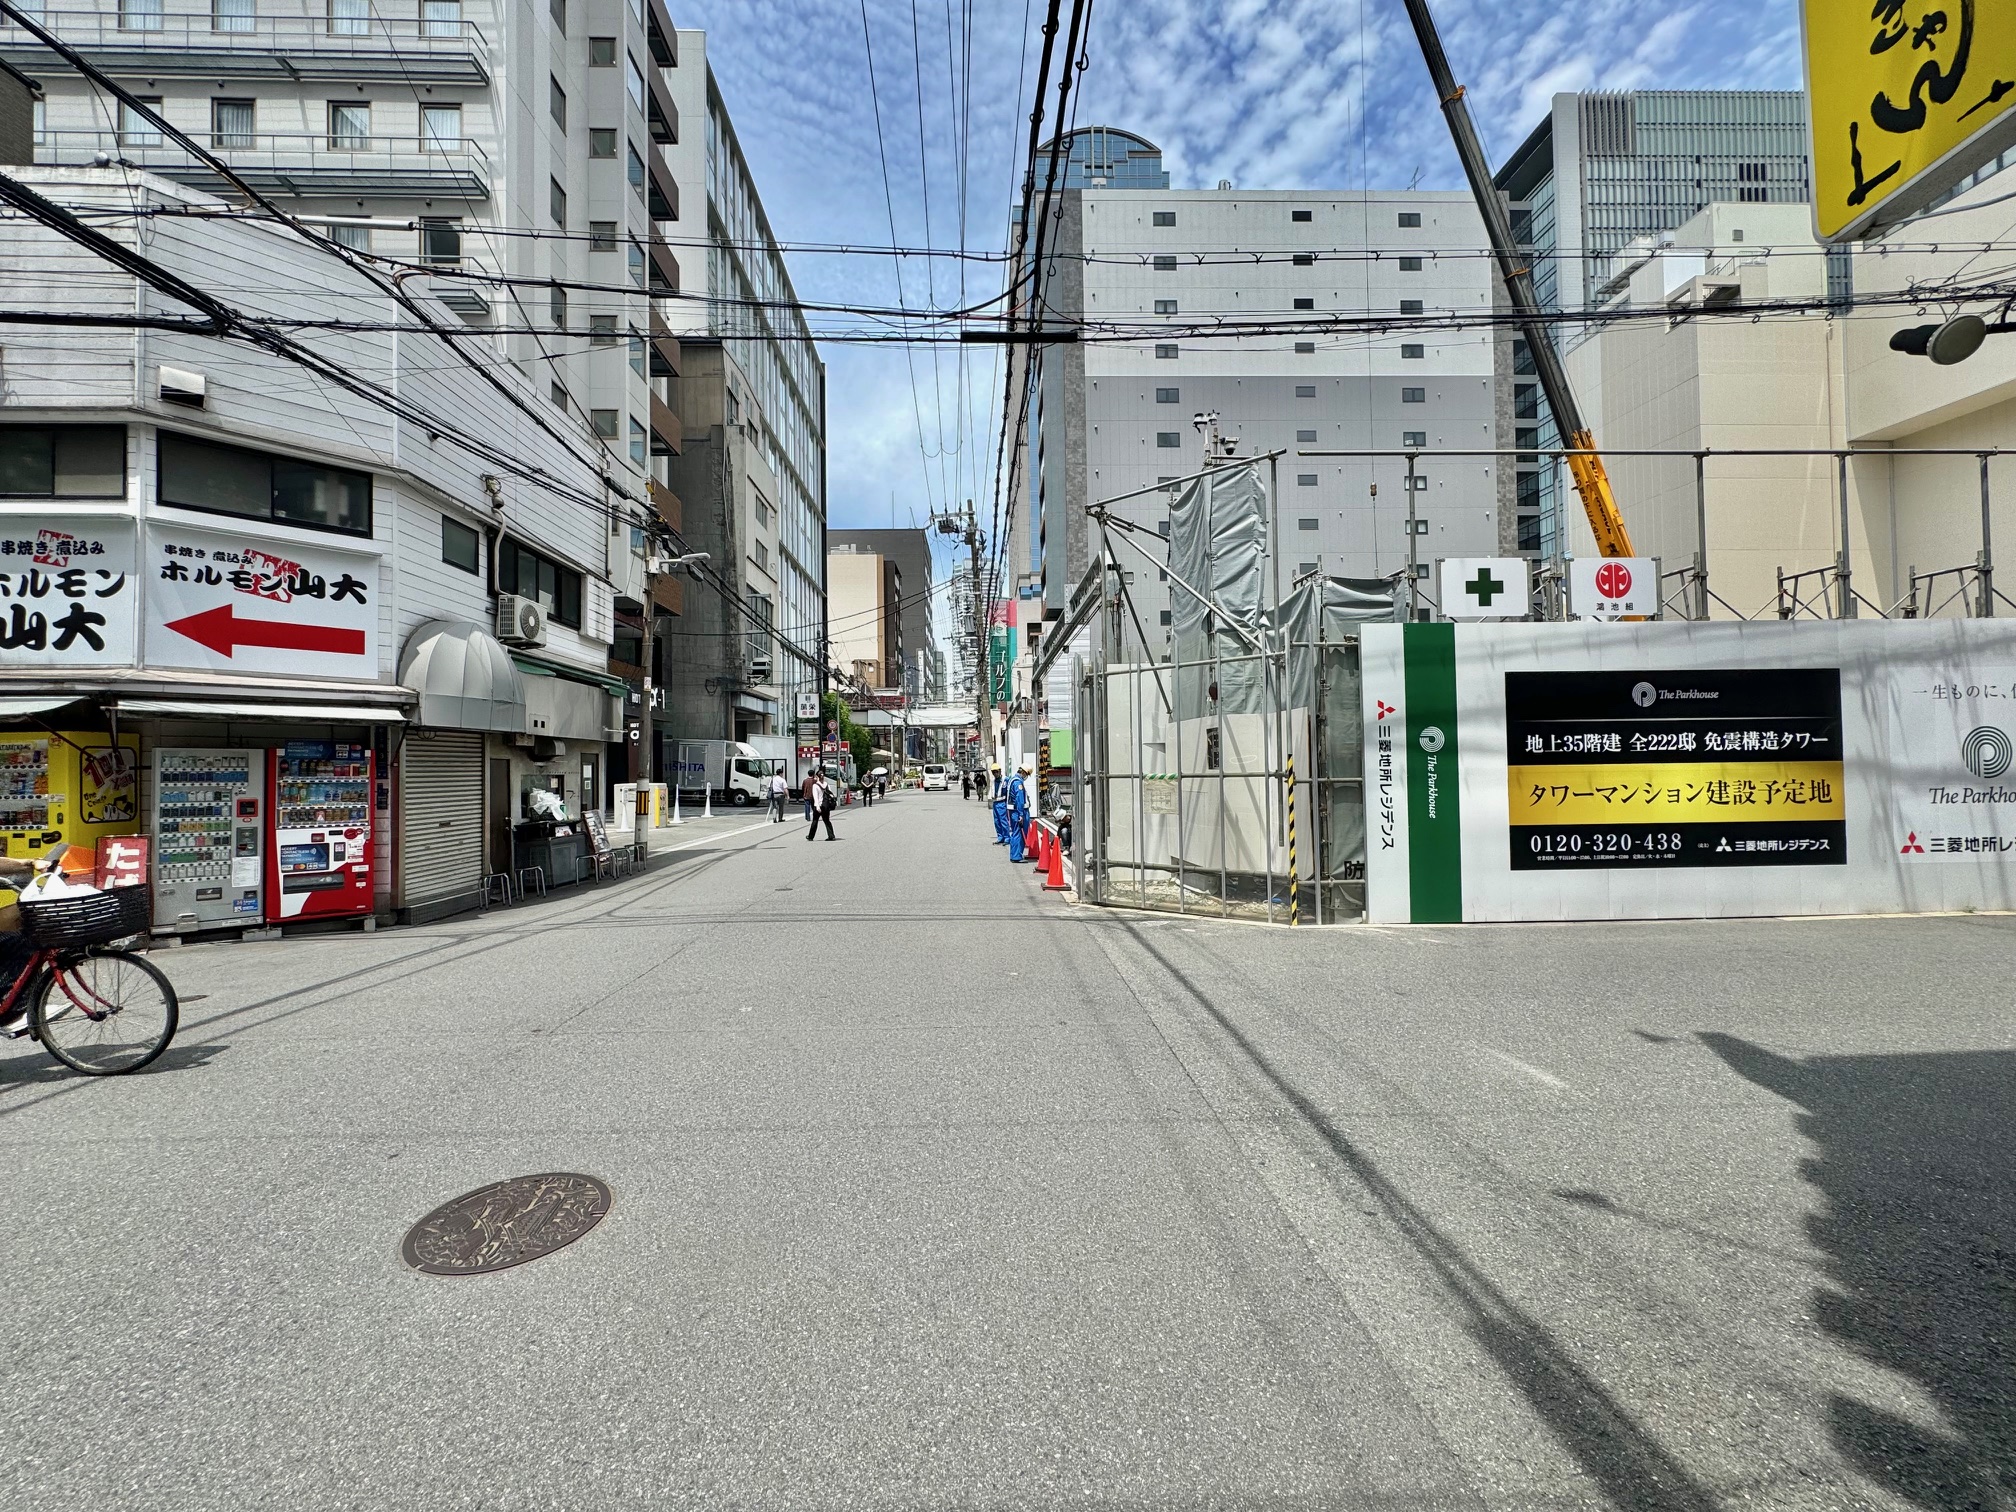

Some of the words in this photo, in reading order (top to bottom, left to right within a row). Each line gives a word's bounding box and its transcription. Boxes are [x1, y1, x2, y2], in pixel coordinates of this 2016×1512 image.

[1, 540, 49, 555] 串焼き
[56, 540, 106, 556] 煮込み
[164, 545, 207, 559] 串焼き
[212, 551, 254, 565] 煮込み
[160, 561, 368, 605] ホルモン山大
[0, 602, 107, 652] 山大
[1658, 690, 1674, 699] The
[1675, 689, 1719, 699] Parkhouse
[1525, 734, 1622, 753] 地上35階建
[1629, 733, 1697, 752] 全222邸
[1704, 731, 1829, 751] 免震構造タワー
[1428, 755, 1437, 772] The
[1378, 725, 1394, 850] 三菱地所レジデンス
[1428, 773, 1438, 819] Parkhouse
[1530, 779, 1834, 807] タワーマンション建設予定地
[1929, 788, 1958, 804] The
[1530, 832, 1682, 853] 0120-320-438
[1735, 838, 1830, 852] 三菱地所レジデンス
